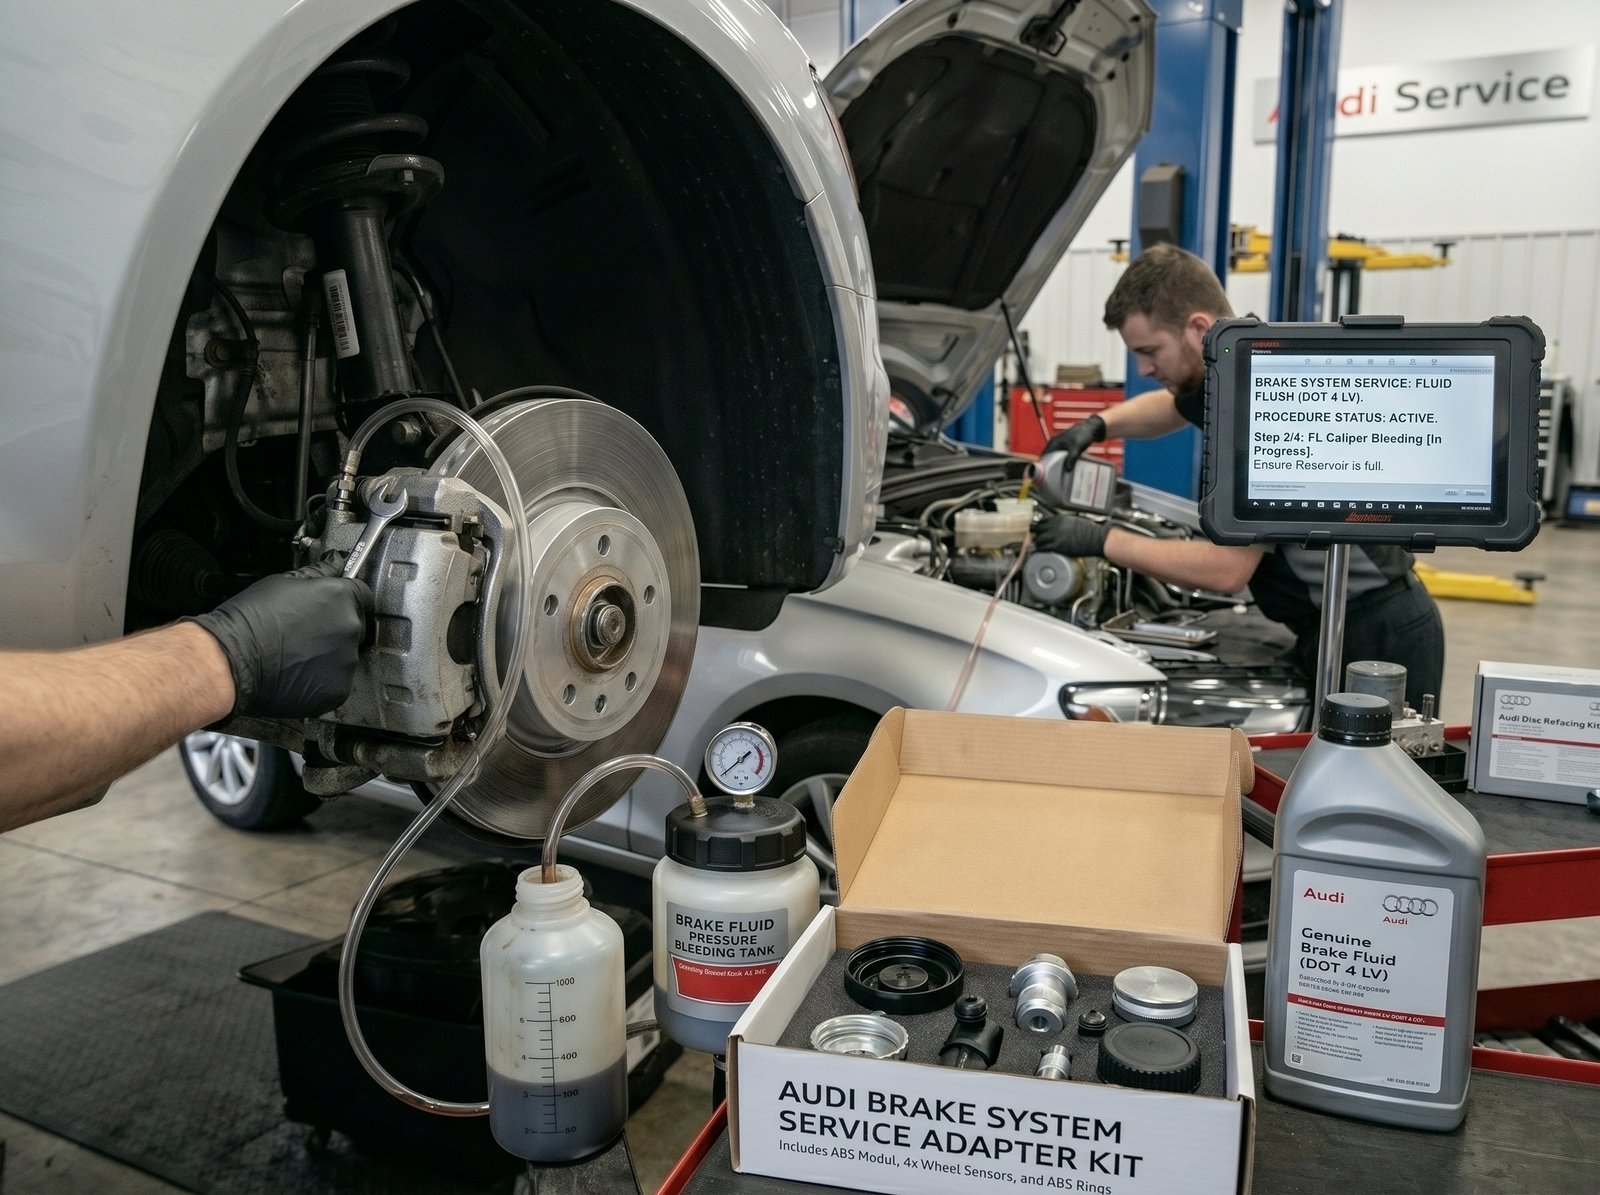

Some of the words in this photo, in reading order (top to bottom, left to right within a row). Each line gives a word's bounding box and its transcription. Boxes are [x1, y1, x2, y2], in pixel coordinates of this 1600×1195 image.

[1395, 70, 1570, 113] Service
[1255, 377, 1298, 388] BRAKE
[1300, 377, 1351, 389] SYSTEM
[1354, 378, 1412, 389] SERVICE:
[1415, 378, 1452, 389] FLUID
[1255, 391, 1295, 402] FLUSH
[1298, 391, 1328, 405] (DOT
[1331, 392, 1338, 402] 4
[1341, 392, 1364, 405] LV).
[1254, 411, 1332, 423] PROCEDURE
[1335, 412, 1386, 424] STATUS:
[1389, 412, 1438, 424] ACTIVE.
[1254, 432, 1281, 445] Step
[1283, 432, 1305, 443] 2/4:
[1308, 433, 1323, 443] FL
[1325, 433, 1368, 446] Caliper
[1371, 433, 1423, 447] Bleeding
[1426, 433, 1442, 447] [In
[1253, 446, 1314, 458] Progress].
[1253, 460, 1292, 470] Ensure
[1295, 460, 1349, 471] Reservoir
[1352, 461, 1361, 471] is
[1364, 460, 1384, 472] full.
[1498, 714, 1520, 722] Audi
[1522, 715, 1542, 724] Disc
[1543, 718, 1585, 730] Refacing
[1587, 722, 1600, 730] Kit
[1303, 887, 1345, 904] Audi
[676, 913, 724, 932] BRAKE
[729, 919, 775, 933] FLUID
[1382, 916, 1408, 926] Audi
[689, 931, 758, 946] PRESSURE
[1301, 927, 1372, 948] Genuine
[675, 939, 735, 958] BLEEDING
[739, 945, 775, 958] TANK
[1301, 942, 1348, 960] Brake
[1353, 951, 1396, 967] Fluid
[1300, 957, 1341, 973] (DOT
[1345, 965, 1357, 976] 4
[1362, 967, 1388, 982] LV)
[555, 977, 575, 987] 1000
[559, 1014, 576, 1024] 600
[560, 1051, 578, 1060] 400
[778, 1080, 856, 1111] AUDI
[867, 1090, 976, 1127] BRAKE
[986, 1106, 1123, 1144] SYSTEM
[778, 1110, 911, 1148] SERVICE
[919, 1127, 1077, 1170] ADAPTER
[1089, 1151, 1143, 1178] KIT
[778, 1139, 828, 1158] Includes
[830, 1145, 856, 1161] ABS
[857, 1148, 900, 1169] Modul,
[902, 1155, 919, 1170] 4x
[920, 1157, 962, 1176] Wheel
[963, 1163, 1018, 1185] Sensors,
[1020, 1171, 1045, 1187] and
[1046, 1173, 1074, 1190] ABS
[1076, 1177, 1112, 1195] Rings
